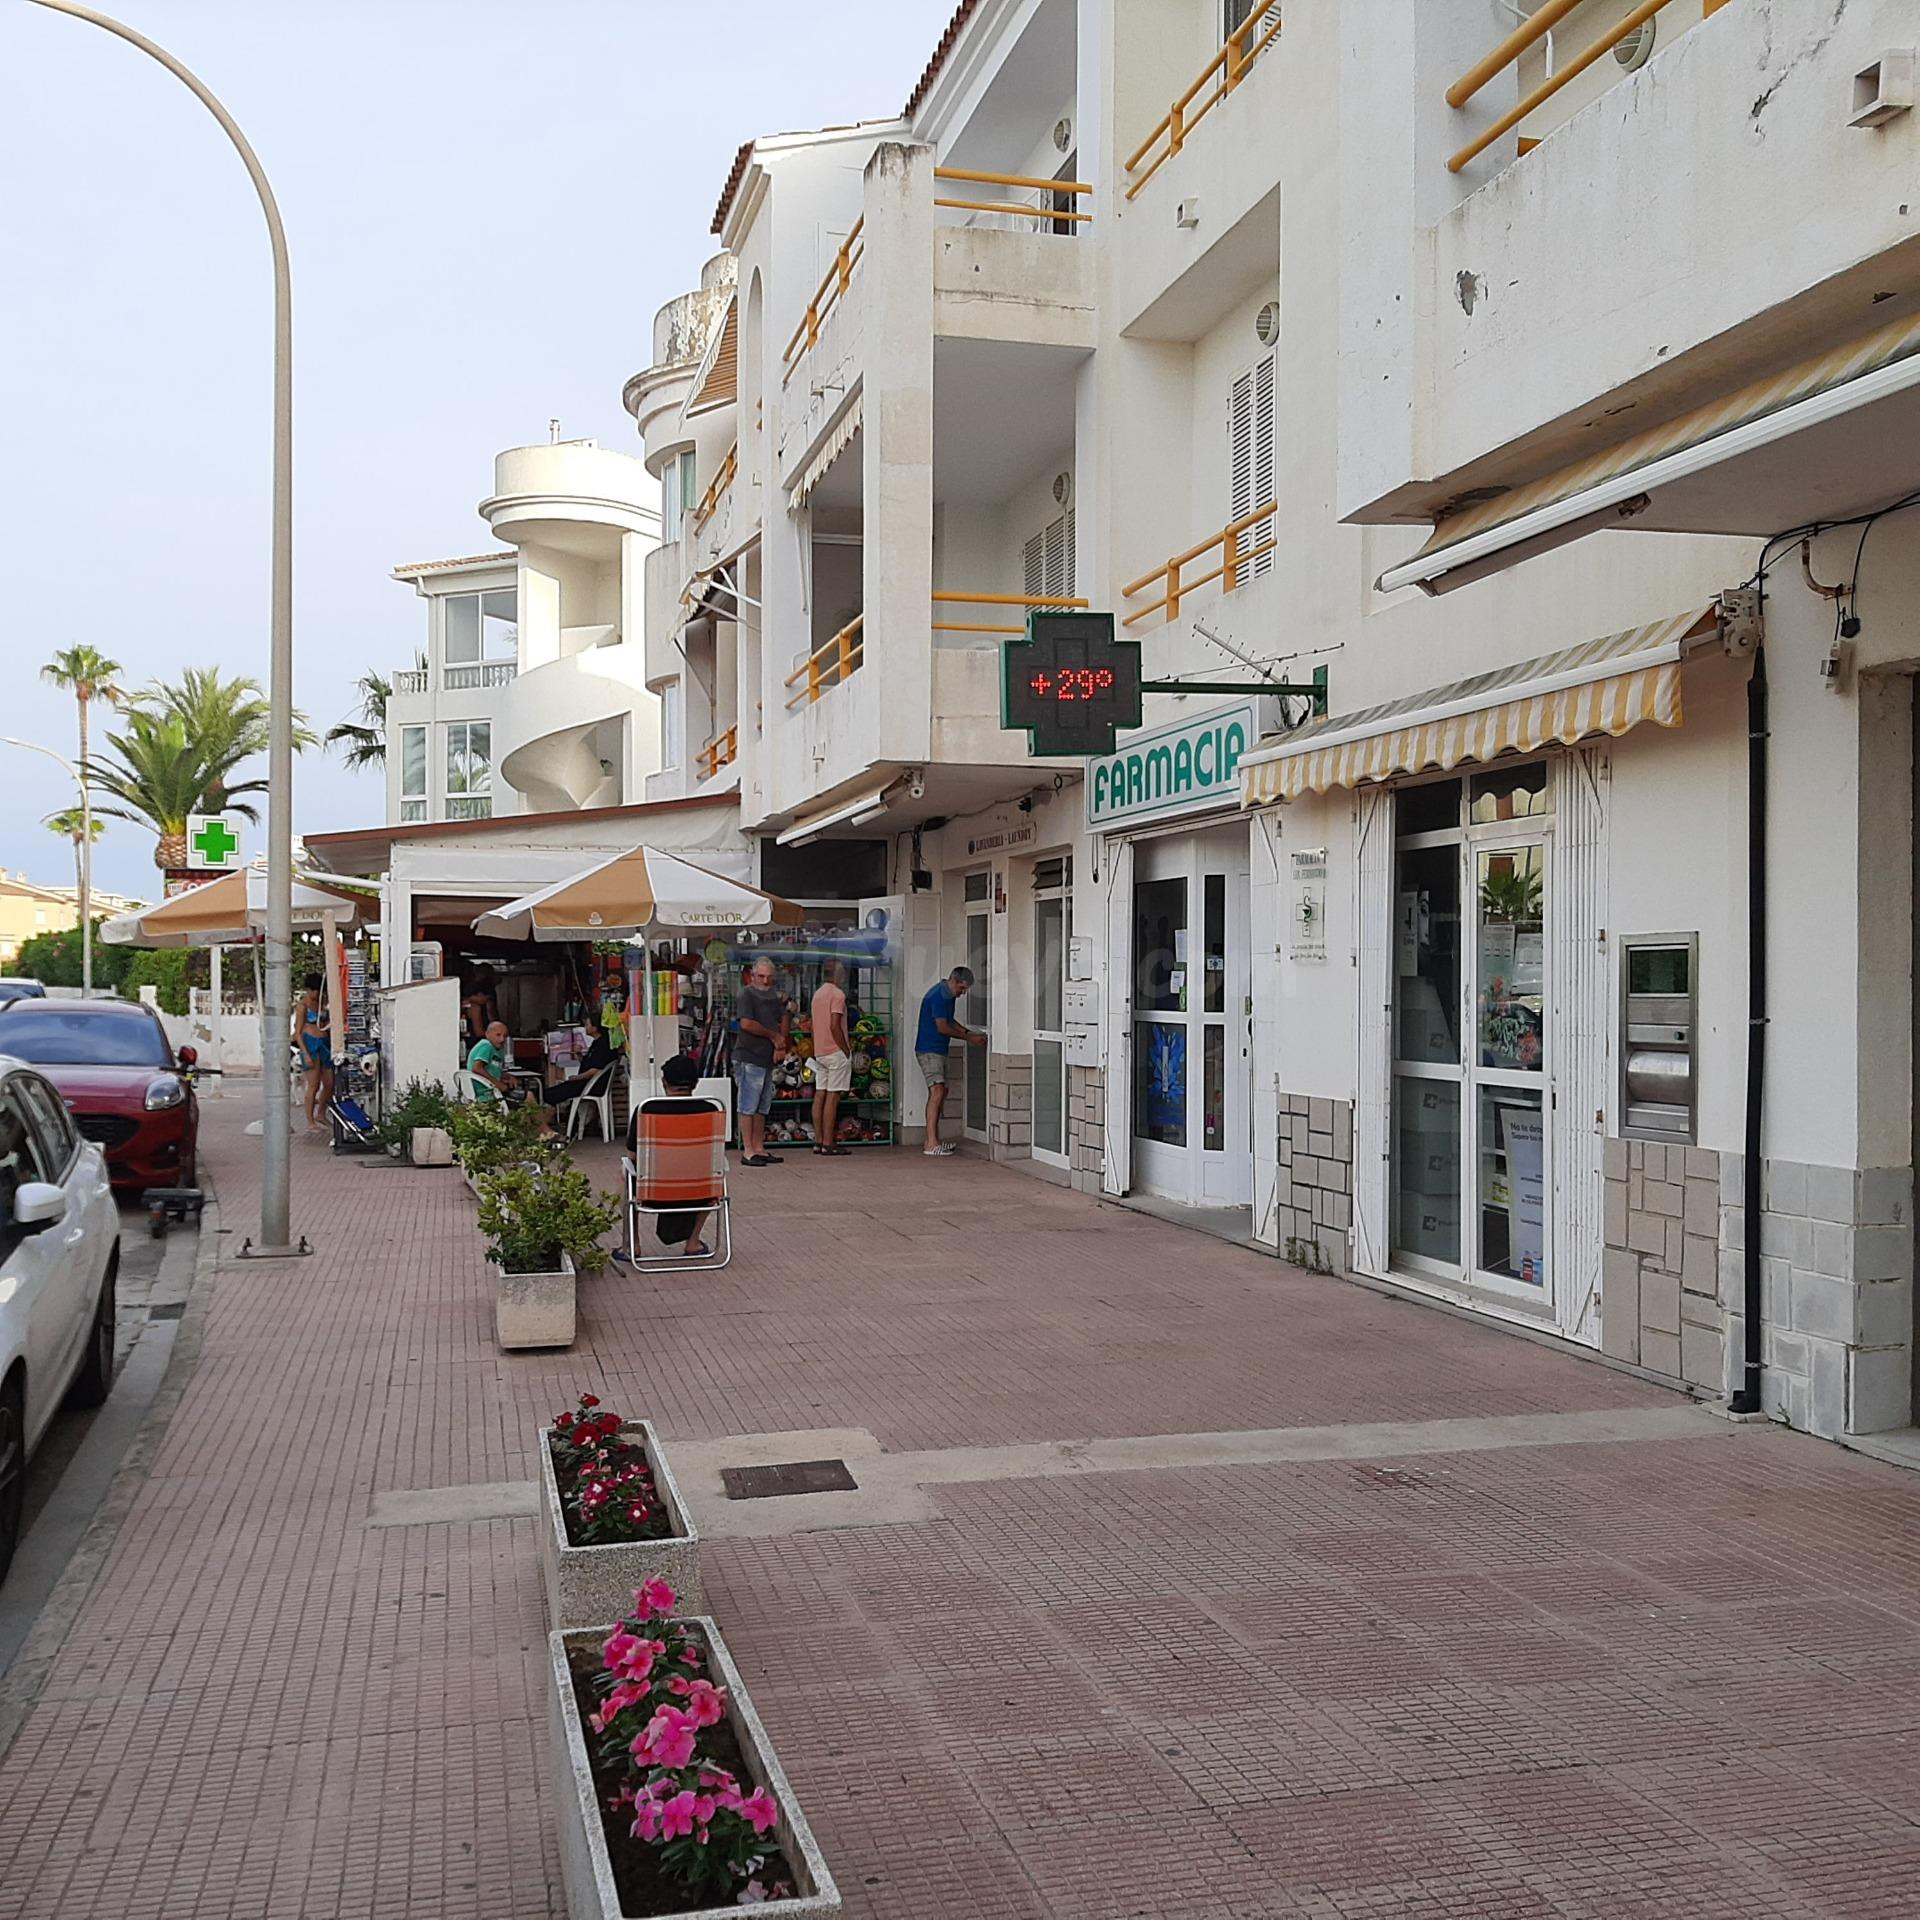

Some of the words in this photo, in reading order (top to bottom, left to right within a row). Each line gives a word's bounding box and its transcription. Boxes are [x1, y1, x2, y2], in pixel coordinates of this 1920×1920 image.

[1094, 721, 1245, 814] FARMACIA
[1008, 828, 1031, 844] LAUNDRY
[680, 911, 713, 925] CARTE
